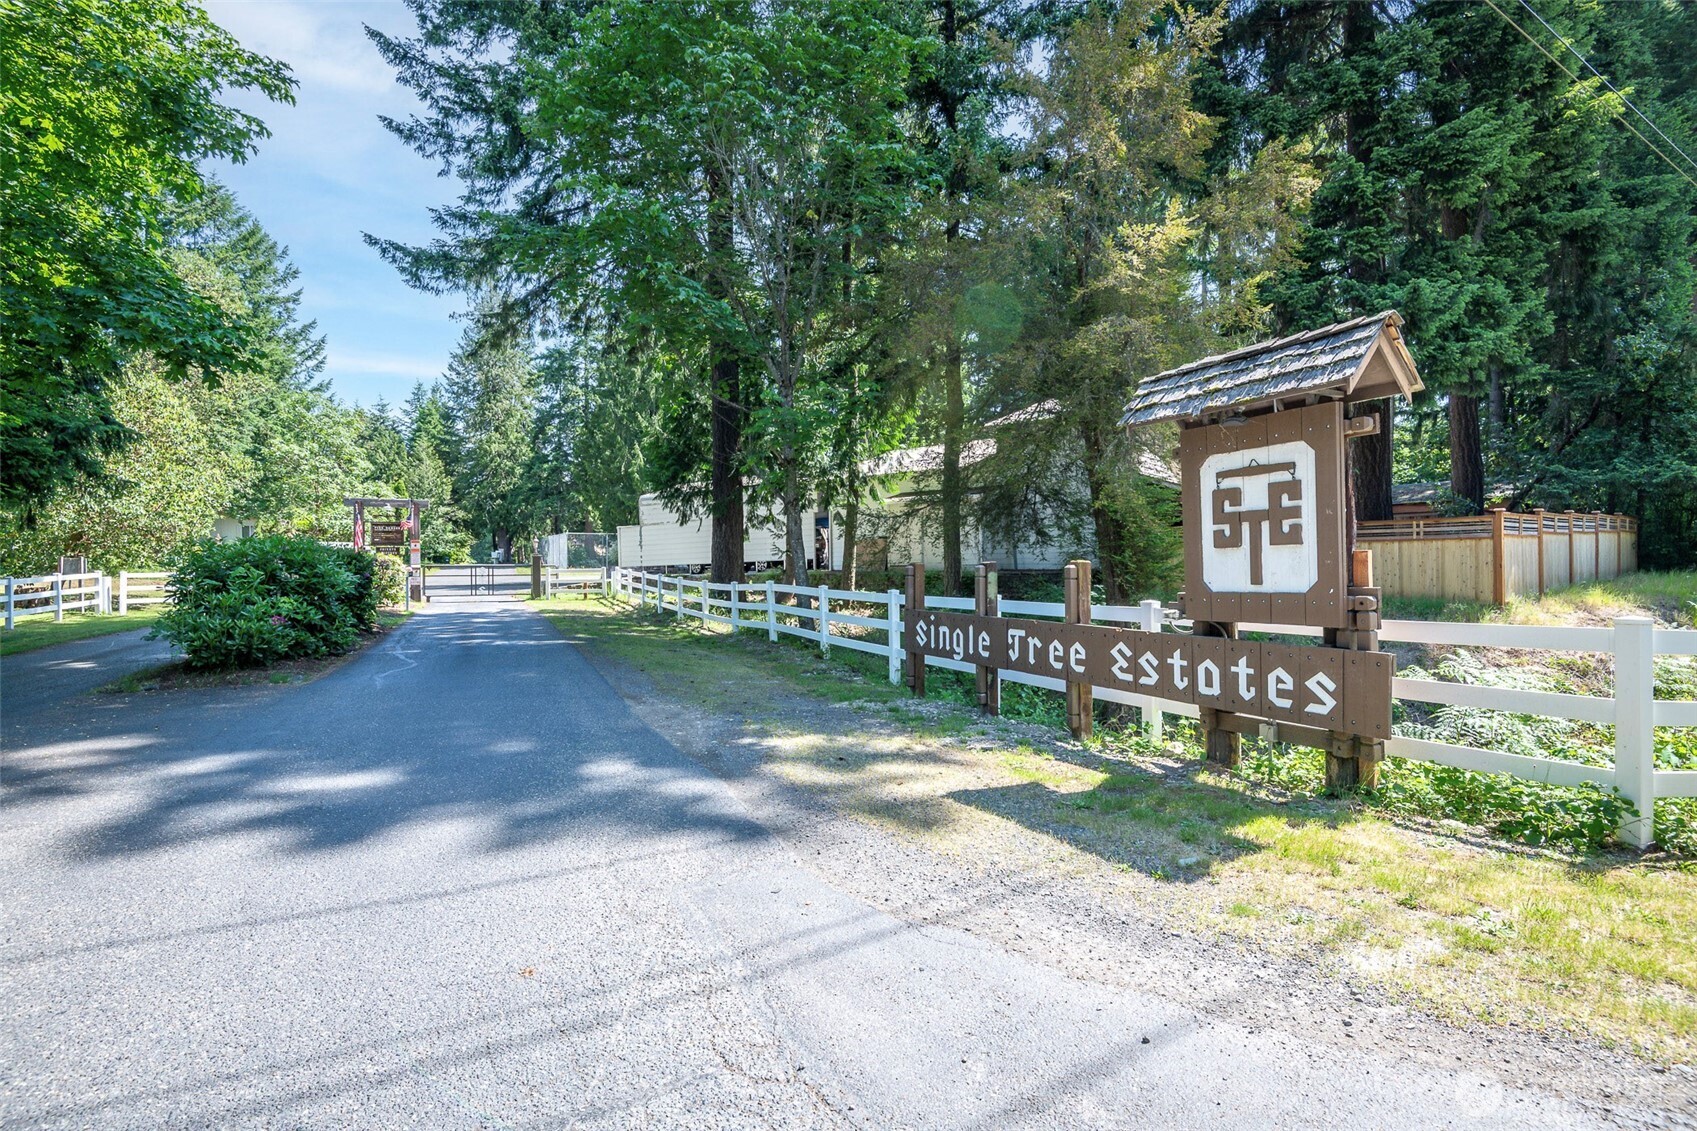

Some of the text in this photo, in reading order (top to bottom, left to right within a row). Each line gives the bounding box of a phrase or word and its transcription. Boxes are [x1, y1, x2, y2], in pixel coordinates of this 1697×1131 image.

[915, 613, 1338, 716] Single Tree Estates
